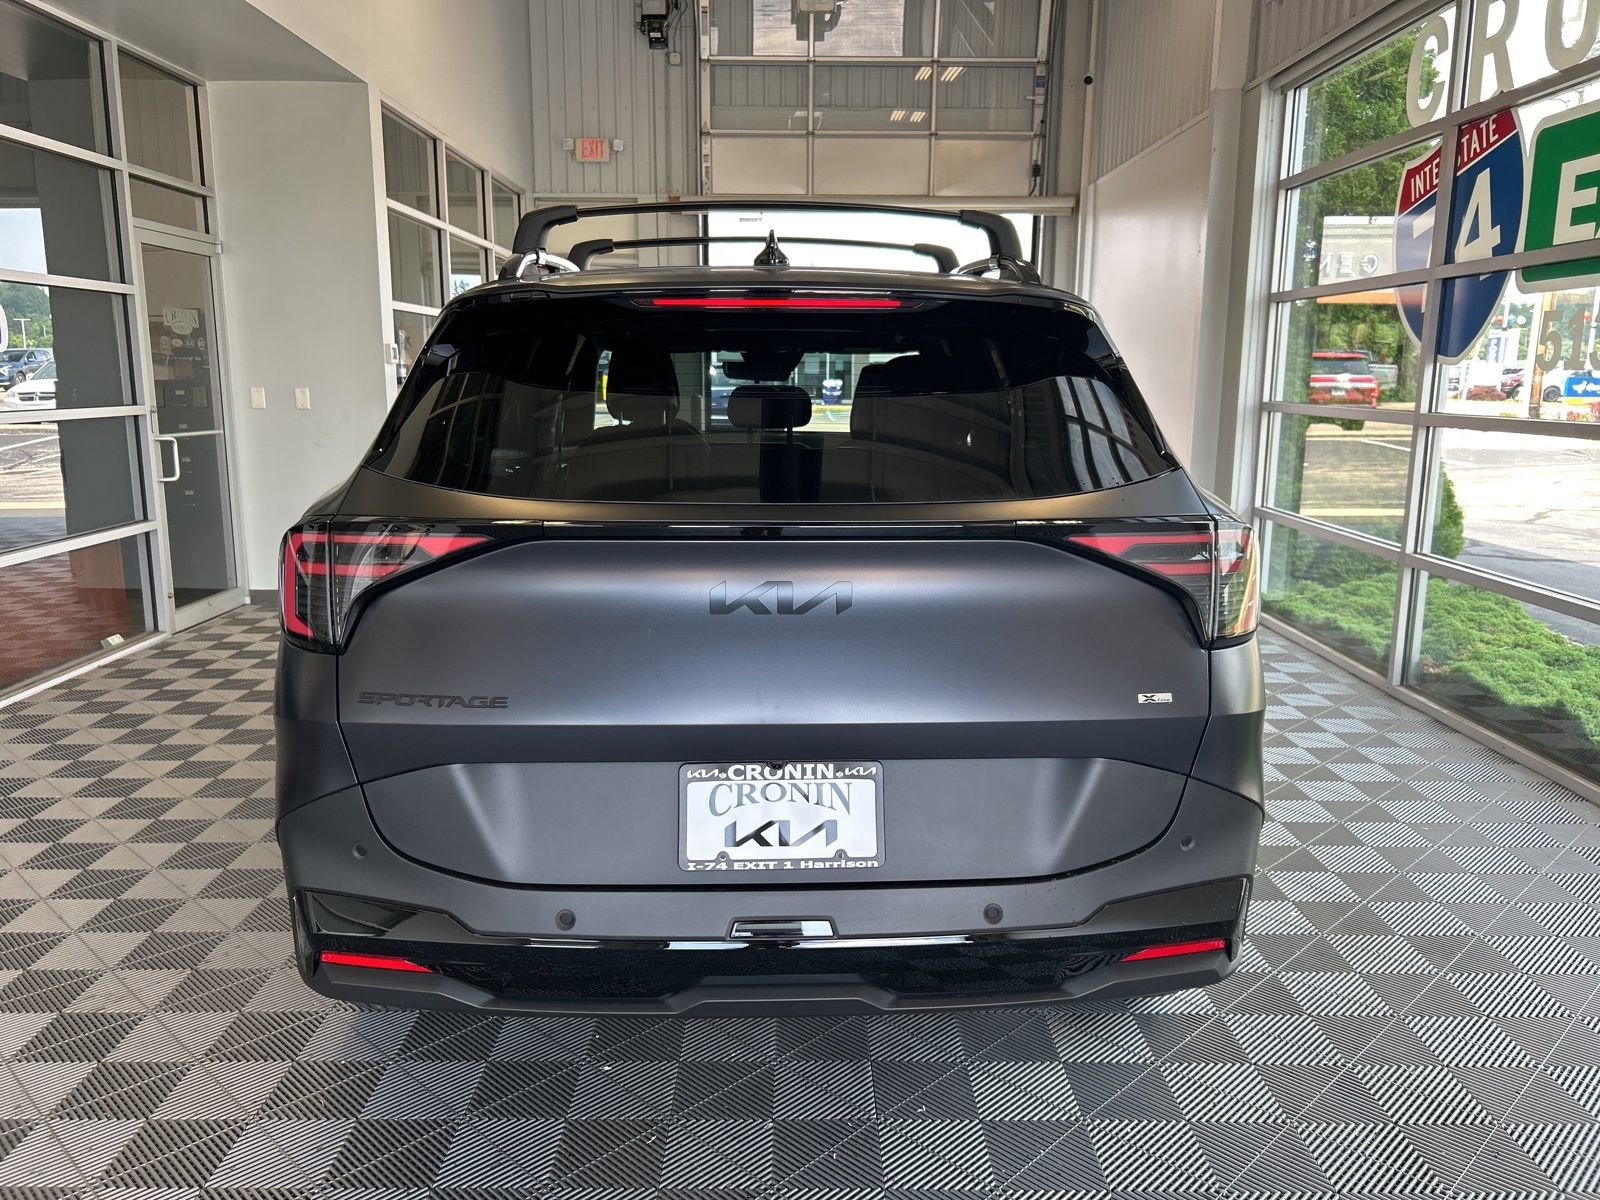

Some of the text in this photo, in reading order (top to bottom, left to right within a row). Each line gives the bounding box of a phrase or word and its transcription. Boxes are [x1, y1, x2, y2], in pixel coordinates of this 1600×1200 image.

[581, 139, 605, 159] EXIT
[1410, 113, 1499, 202] INTETATE
[1552, 154, 1600, 246] E
[709, 580, 853, 615] KIA
[357, 691, 509, 709] SPORTAGE
[687, 763, 877, 781] KIA CRONIN KIA
[708, 782, 853, 817] CRONIN
[724, 819, 838, 848] KIA
[687, 859, 879, 871] I-74 EXIT 1 Harrison
